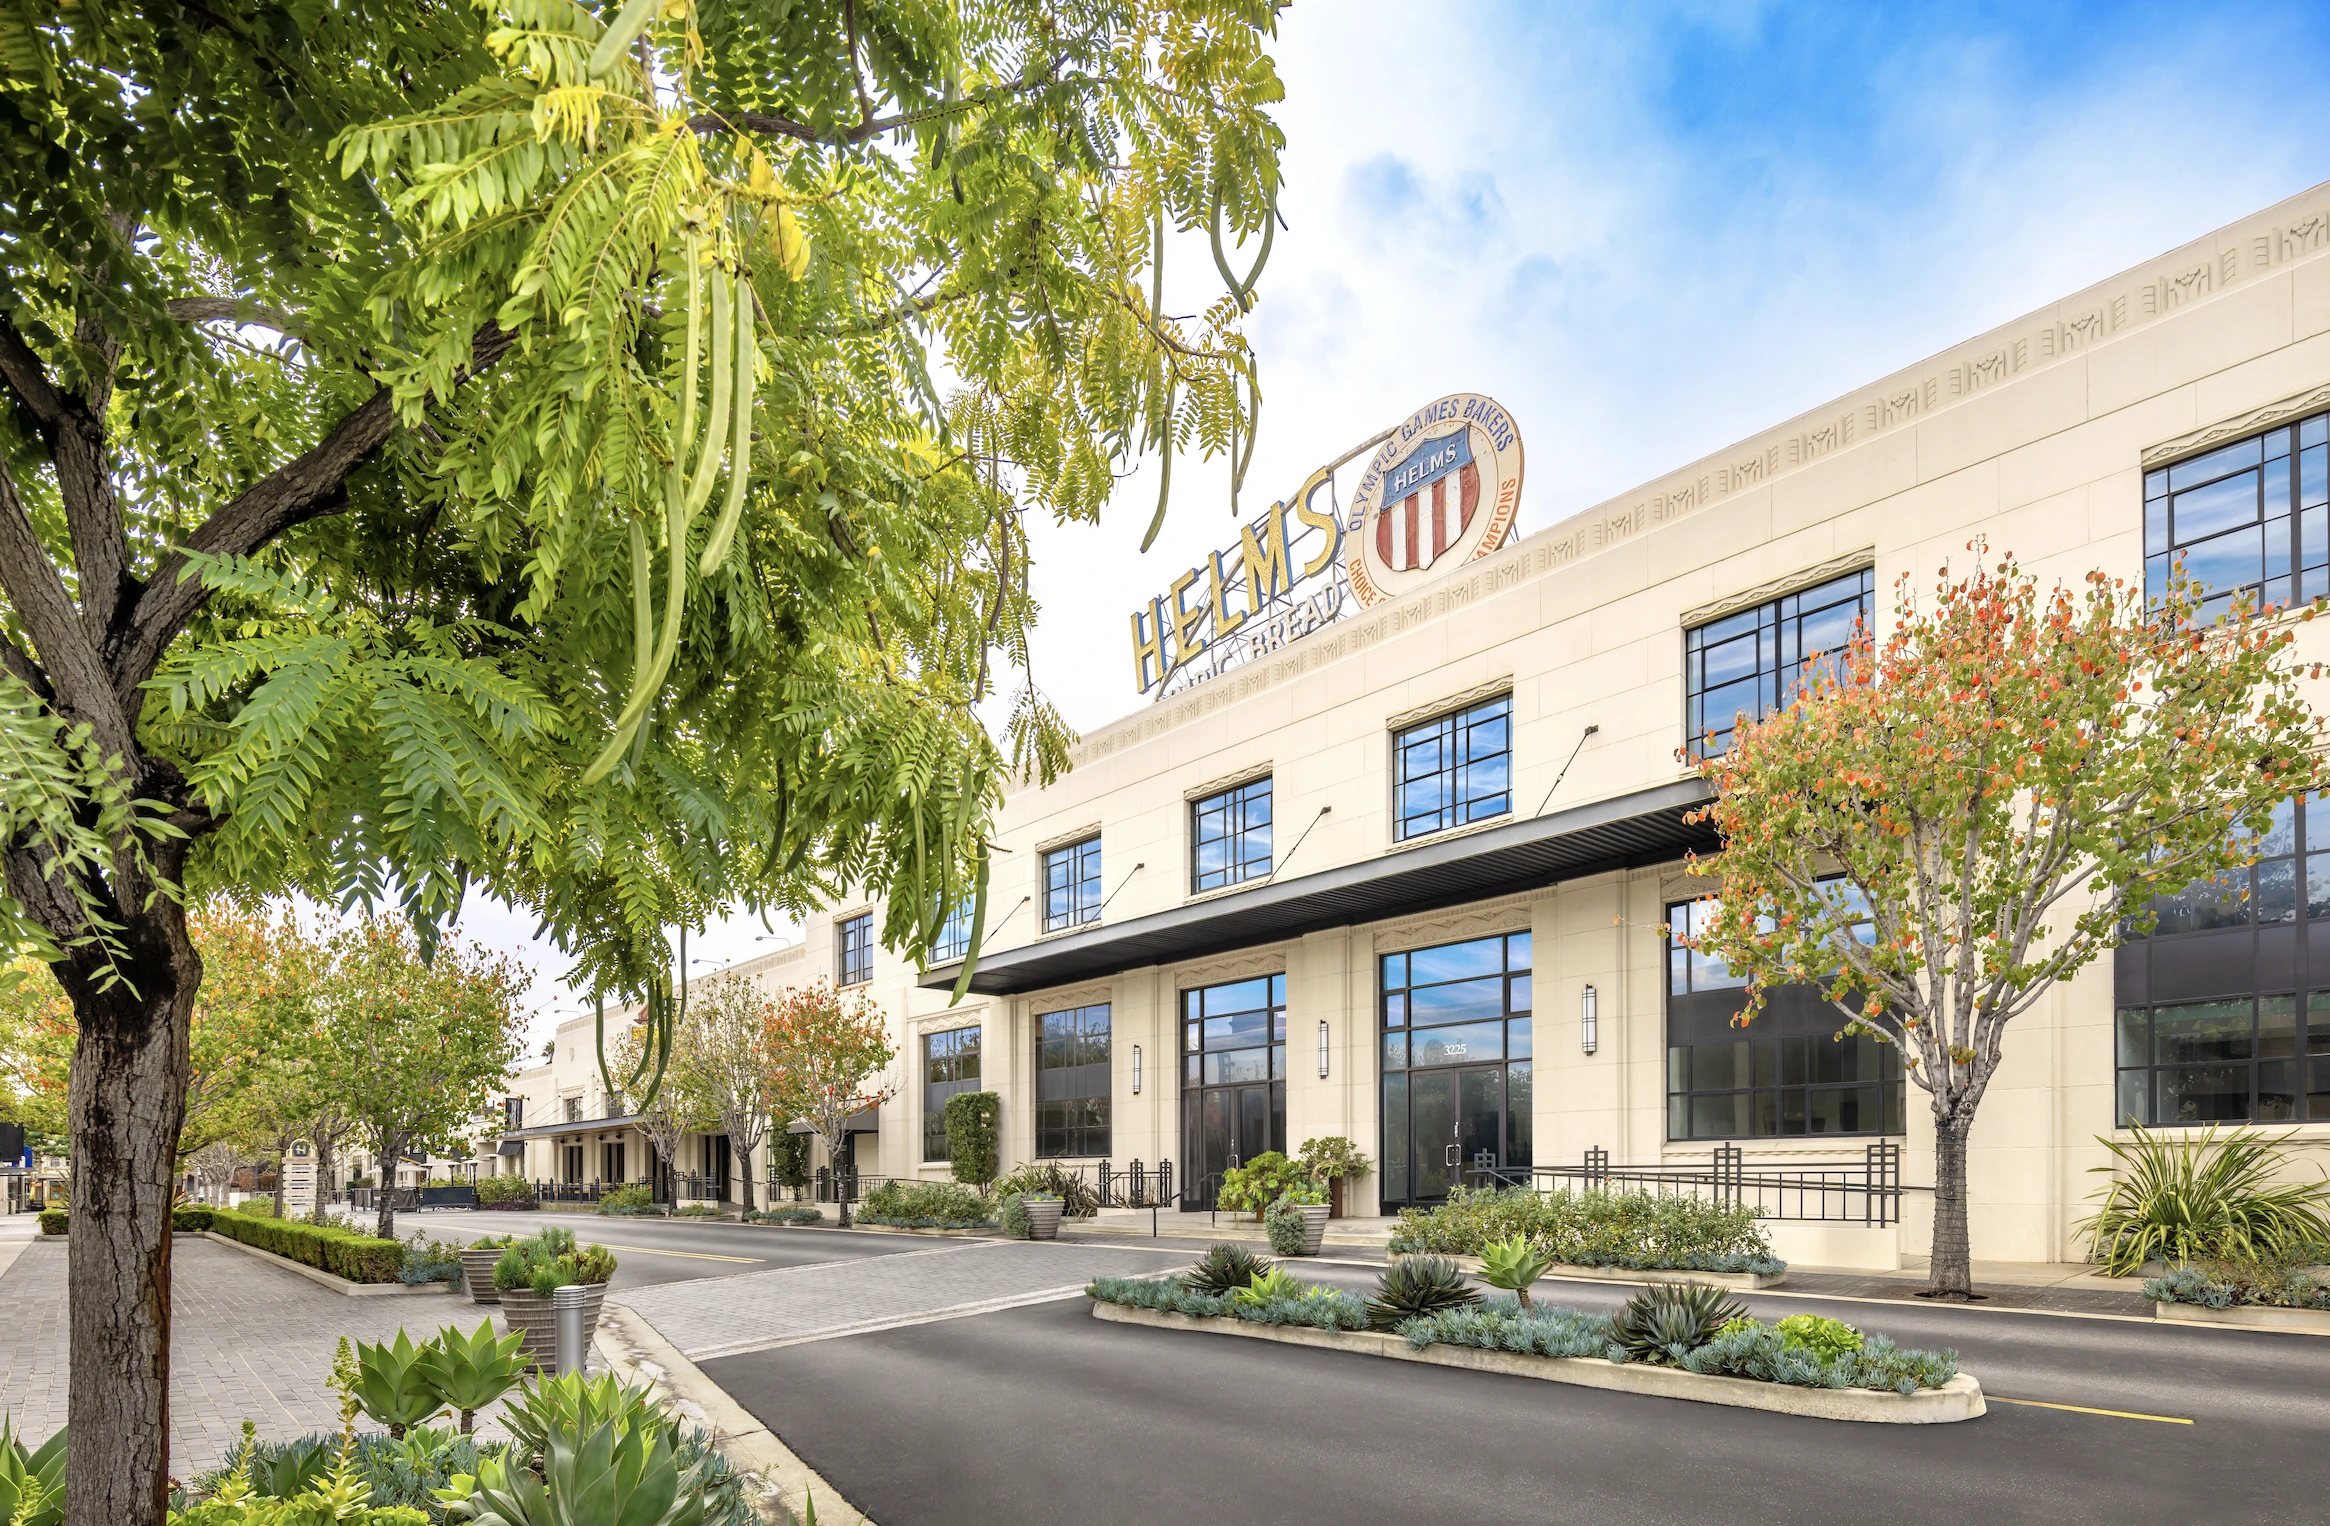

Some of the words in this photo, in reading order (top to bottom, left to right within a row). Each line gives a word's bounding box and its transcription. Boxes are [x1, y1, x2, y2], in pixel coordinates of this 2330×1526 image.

[1349, 441, 1398, 532] OLYMPIC
[1401, 398, 1460, 442] GAMES
[1463, 398, 1515, 453] BAKERS
[1393, 443, 1457, 493] HELMS
[1131, 465, 1342, 695] HELMS
[1349, 558, 1377, 607] CHOICE
[1472, 477, 1517, 561] AMPIONS
[1249, 581, 1343, 660] BREAD
[1444, 1044, 1467, 1056] 3225
